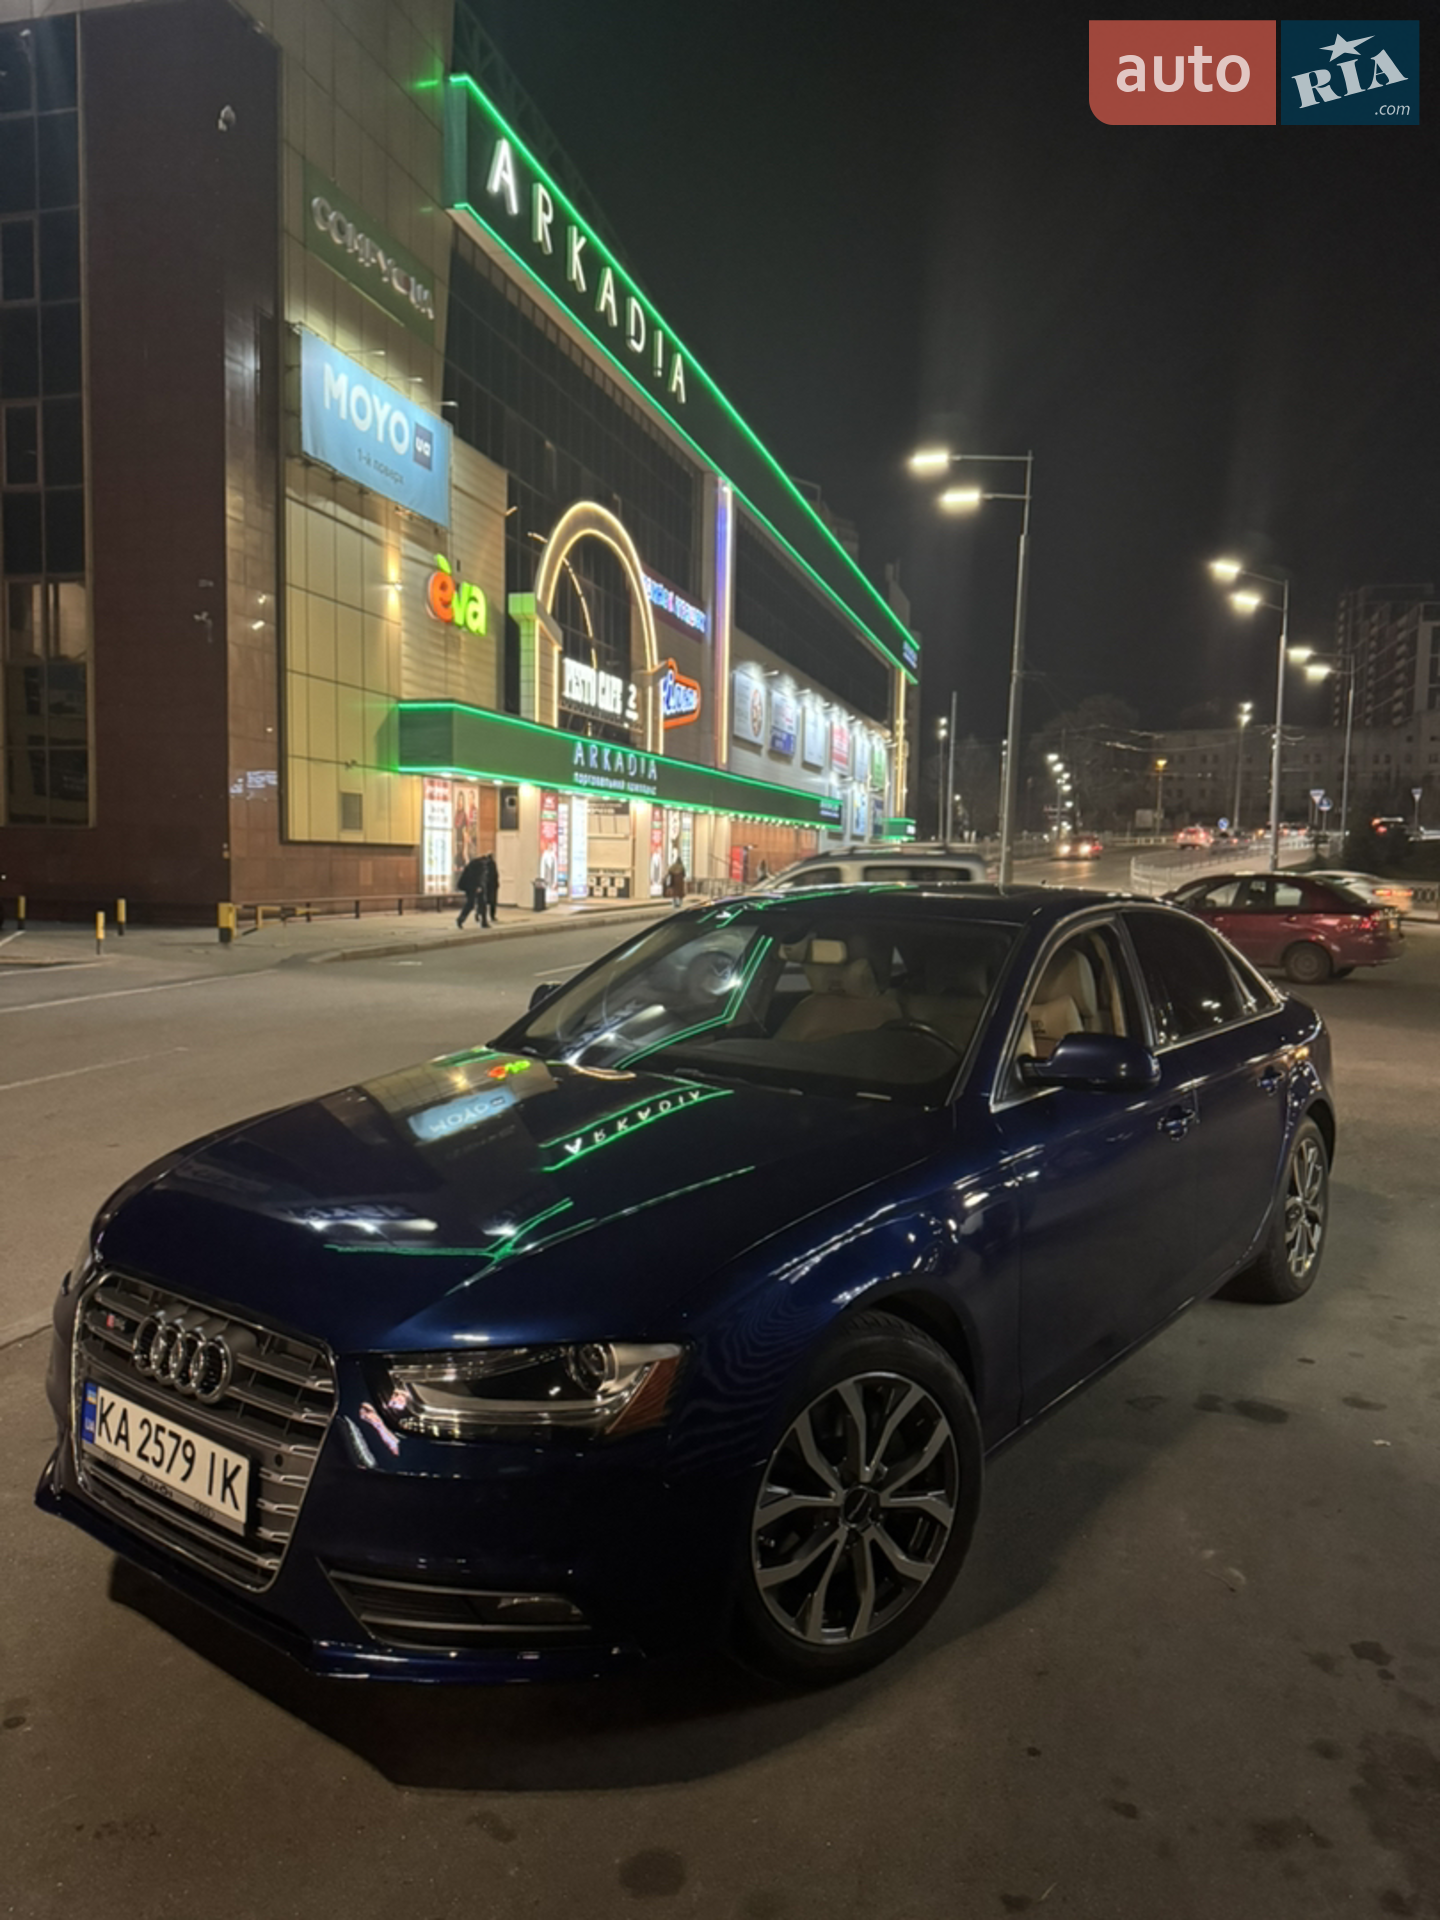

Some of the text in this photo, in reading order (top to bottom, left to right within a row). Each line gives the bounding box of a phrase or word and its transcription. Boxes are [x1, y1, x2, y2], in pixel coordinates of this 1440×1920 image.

[487, 137, 687, 404] ARKADIA
[323, 362, 410, 456] MOYO
[627, 683, 638, 710] 2
[573, 741, 657, 780] ARKADIA
[97, 1396, 131, 1453] KA
[136, 1417, 197, 1484] 2579
[207, 1451, 243, 1511] IK
